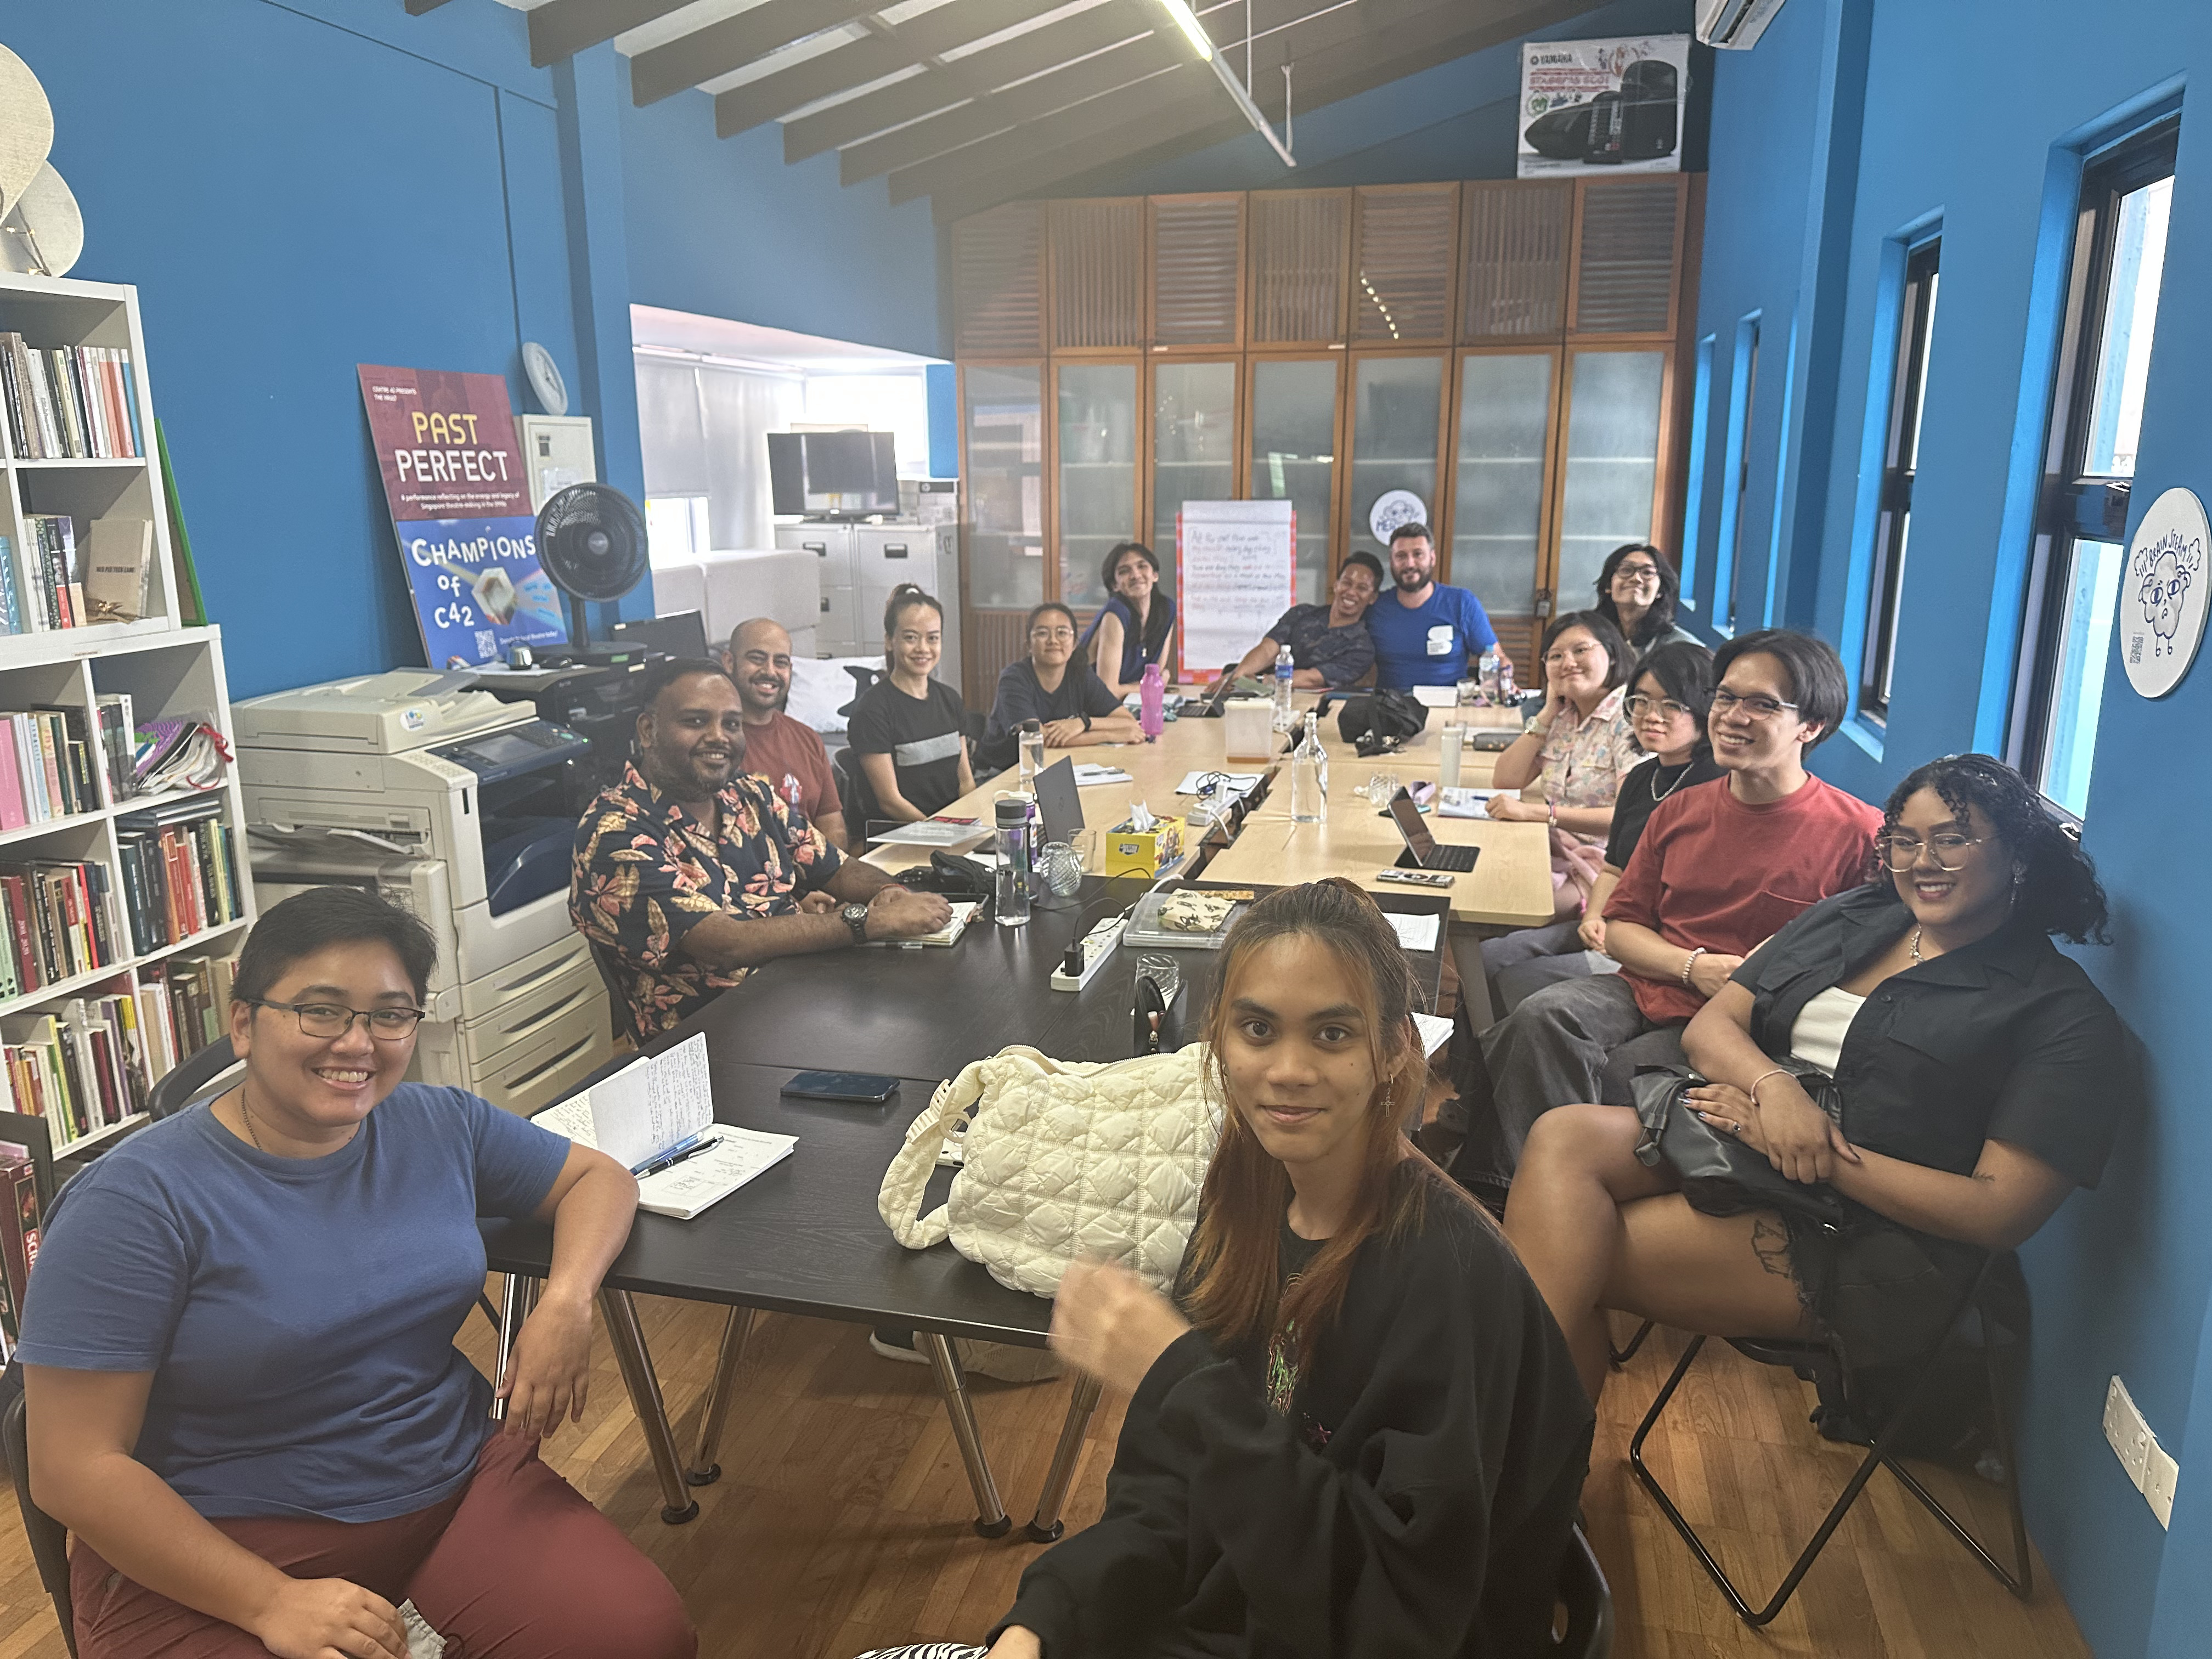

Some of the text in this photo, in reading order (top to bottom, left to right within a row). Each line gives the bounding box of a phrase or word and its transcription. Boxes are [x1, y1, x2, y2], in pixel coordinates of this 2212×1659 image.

[412, 411, 478, 445] PAST
[394, 449, 507, 482] PERFECT
[405, 493, 436, 502] performance
[437, 493, 460, 501] reflecting
[411, 534, 536, 567] CHAMPIONS
[2149, 528, 2187, 567] BRAIN STEAM
[437, 574, 460, 597] of
[435, 602, 475, 629] C42
